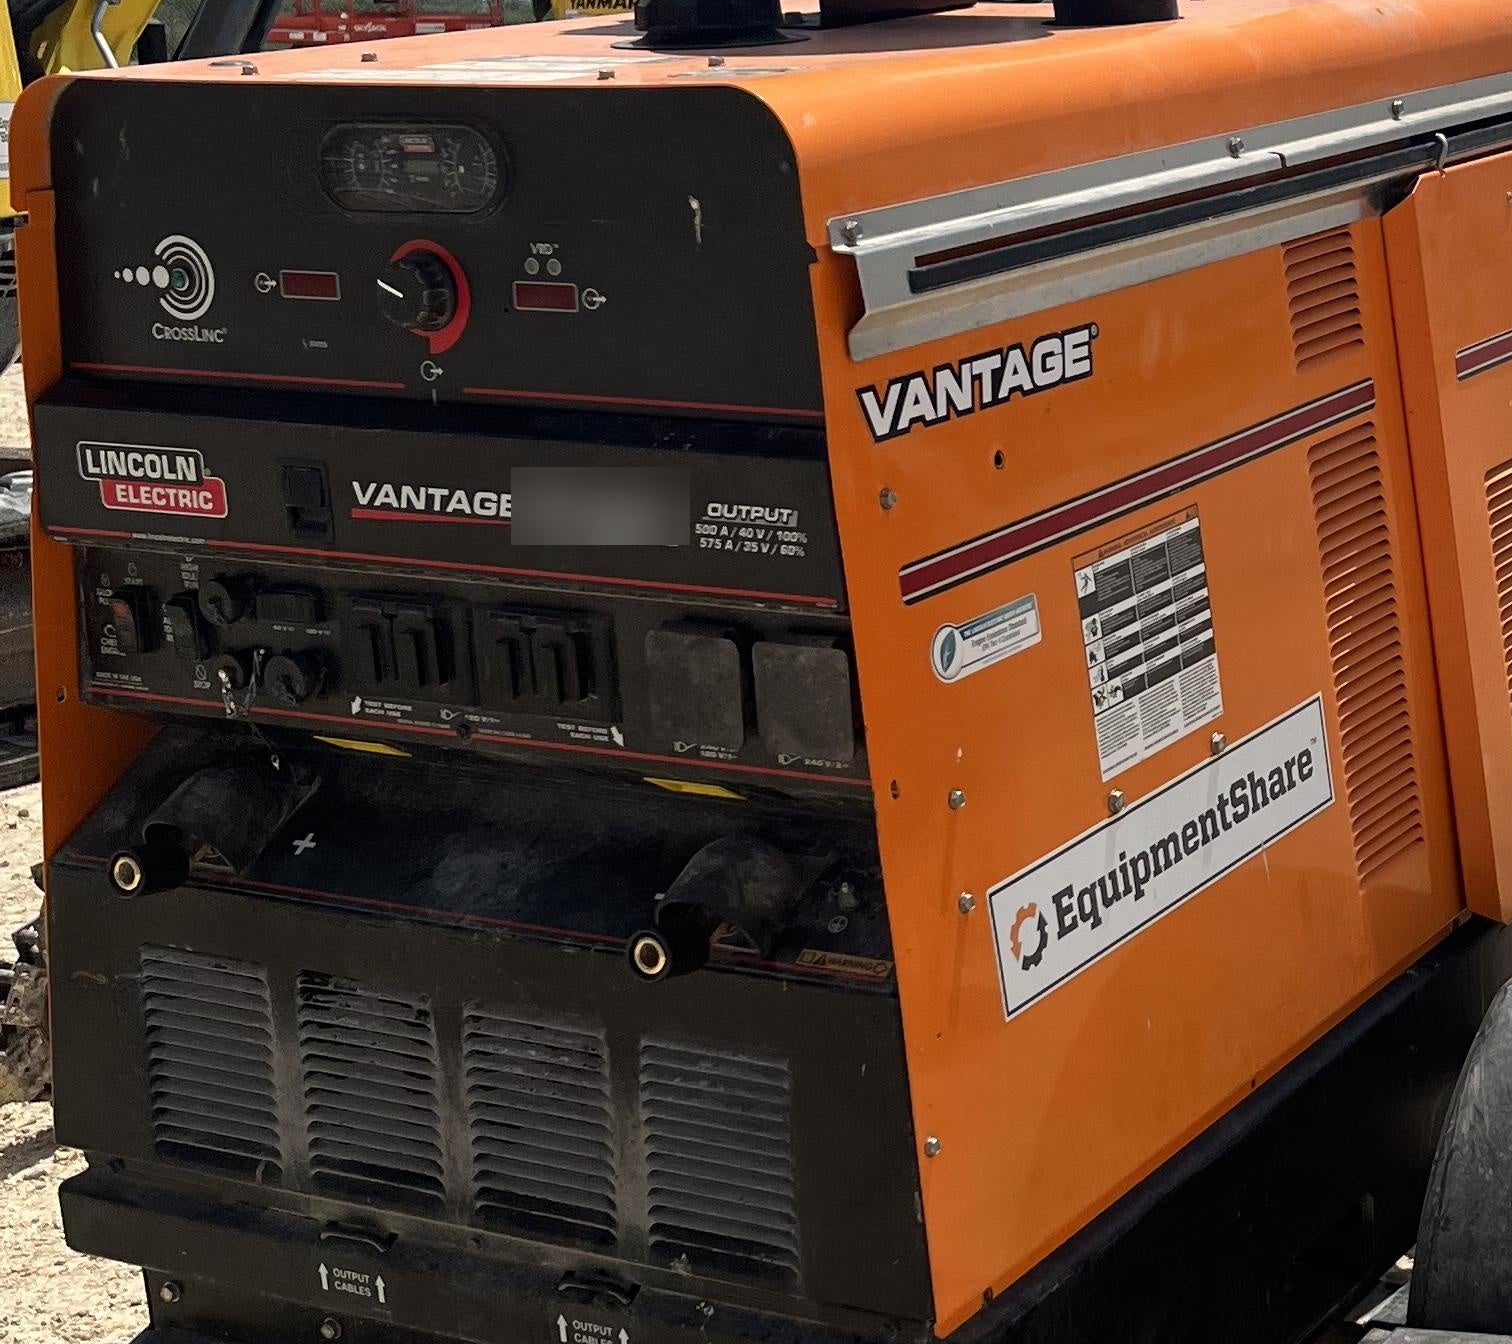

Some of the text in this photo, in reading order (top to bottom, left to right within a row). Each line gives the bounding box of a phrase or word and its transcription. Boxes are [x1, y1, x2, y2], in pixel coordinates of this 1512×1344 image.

[861, 328, 1091, 438] VANTAGE
[85, 448, 198, 482] LINCOLN
[115, 483, 214, 510] ELECTRIC
[707, 502, 793, 523] OUTPUT
[695, 523, 718, 535] 500
[719, 525, 730, 537] A
[738, 527, 754, 539] 40
[755, 528, 766, 540] V
[776, 530, 808, 544] 100%
[699, 537, 723, 549] 575
[724, 539, 734, 551] A
[743, 541, 759, 553] 35
[760, 542, 770, 554] V
[1051, 746, 1314, 941] EquipmentShare
[332, 1267, 370, 1285] OUTPUT
[334, 1280, 372, 1298] CABLES
[571, 1319, 614, 1338] OUTPUT
